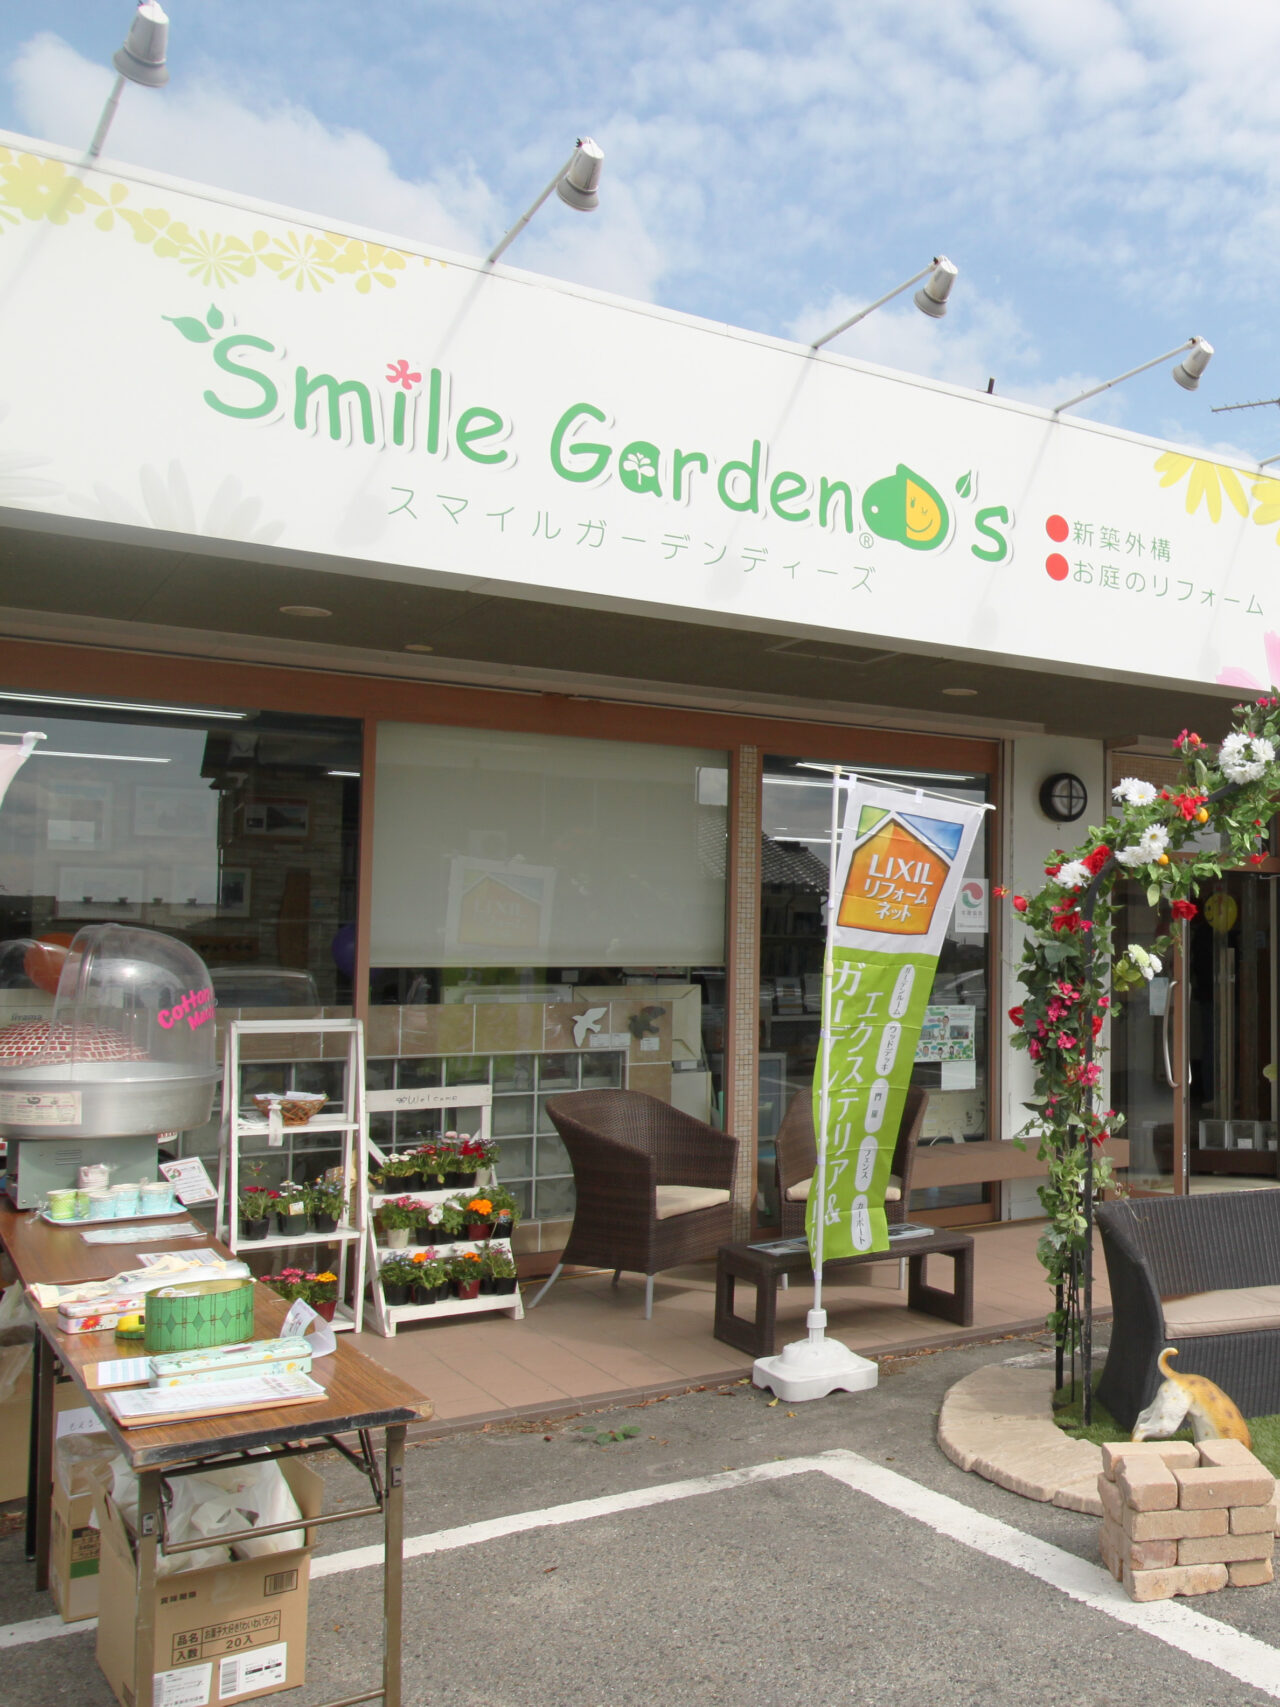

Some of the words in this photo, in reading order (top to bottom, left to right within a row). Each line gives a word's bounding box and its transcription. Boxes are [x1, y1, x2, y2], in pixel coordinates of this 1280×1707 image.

[203, 333, 509, 465] Smile
[550, 402, 855, 534] Garden
[387, 485, 878, 594] スマイルガーデンディーズ
[1073, 520, 1172, 563] 新築外構
[1073, 559, 1264, 616] お庭のリフォーム
[868, 854, 934, 886] LIXIL
[863, 878, 928, 905] リフォーム
[875, 901, 912, 923] ネット
[881, 1025, 898, 1072] ウッドデッキ
[407, 1094, 458, 1105] Welcome
[862, 1149, 871, 1179] フェンス
[856, 1202, 866, 1245] カーポート
[177, 1632, 199, 1646] 品名
[225, 1634, 254, 1650] 20入
